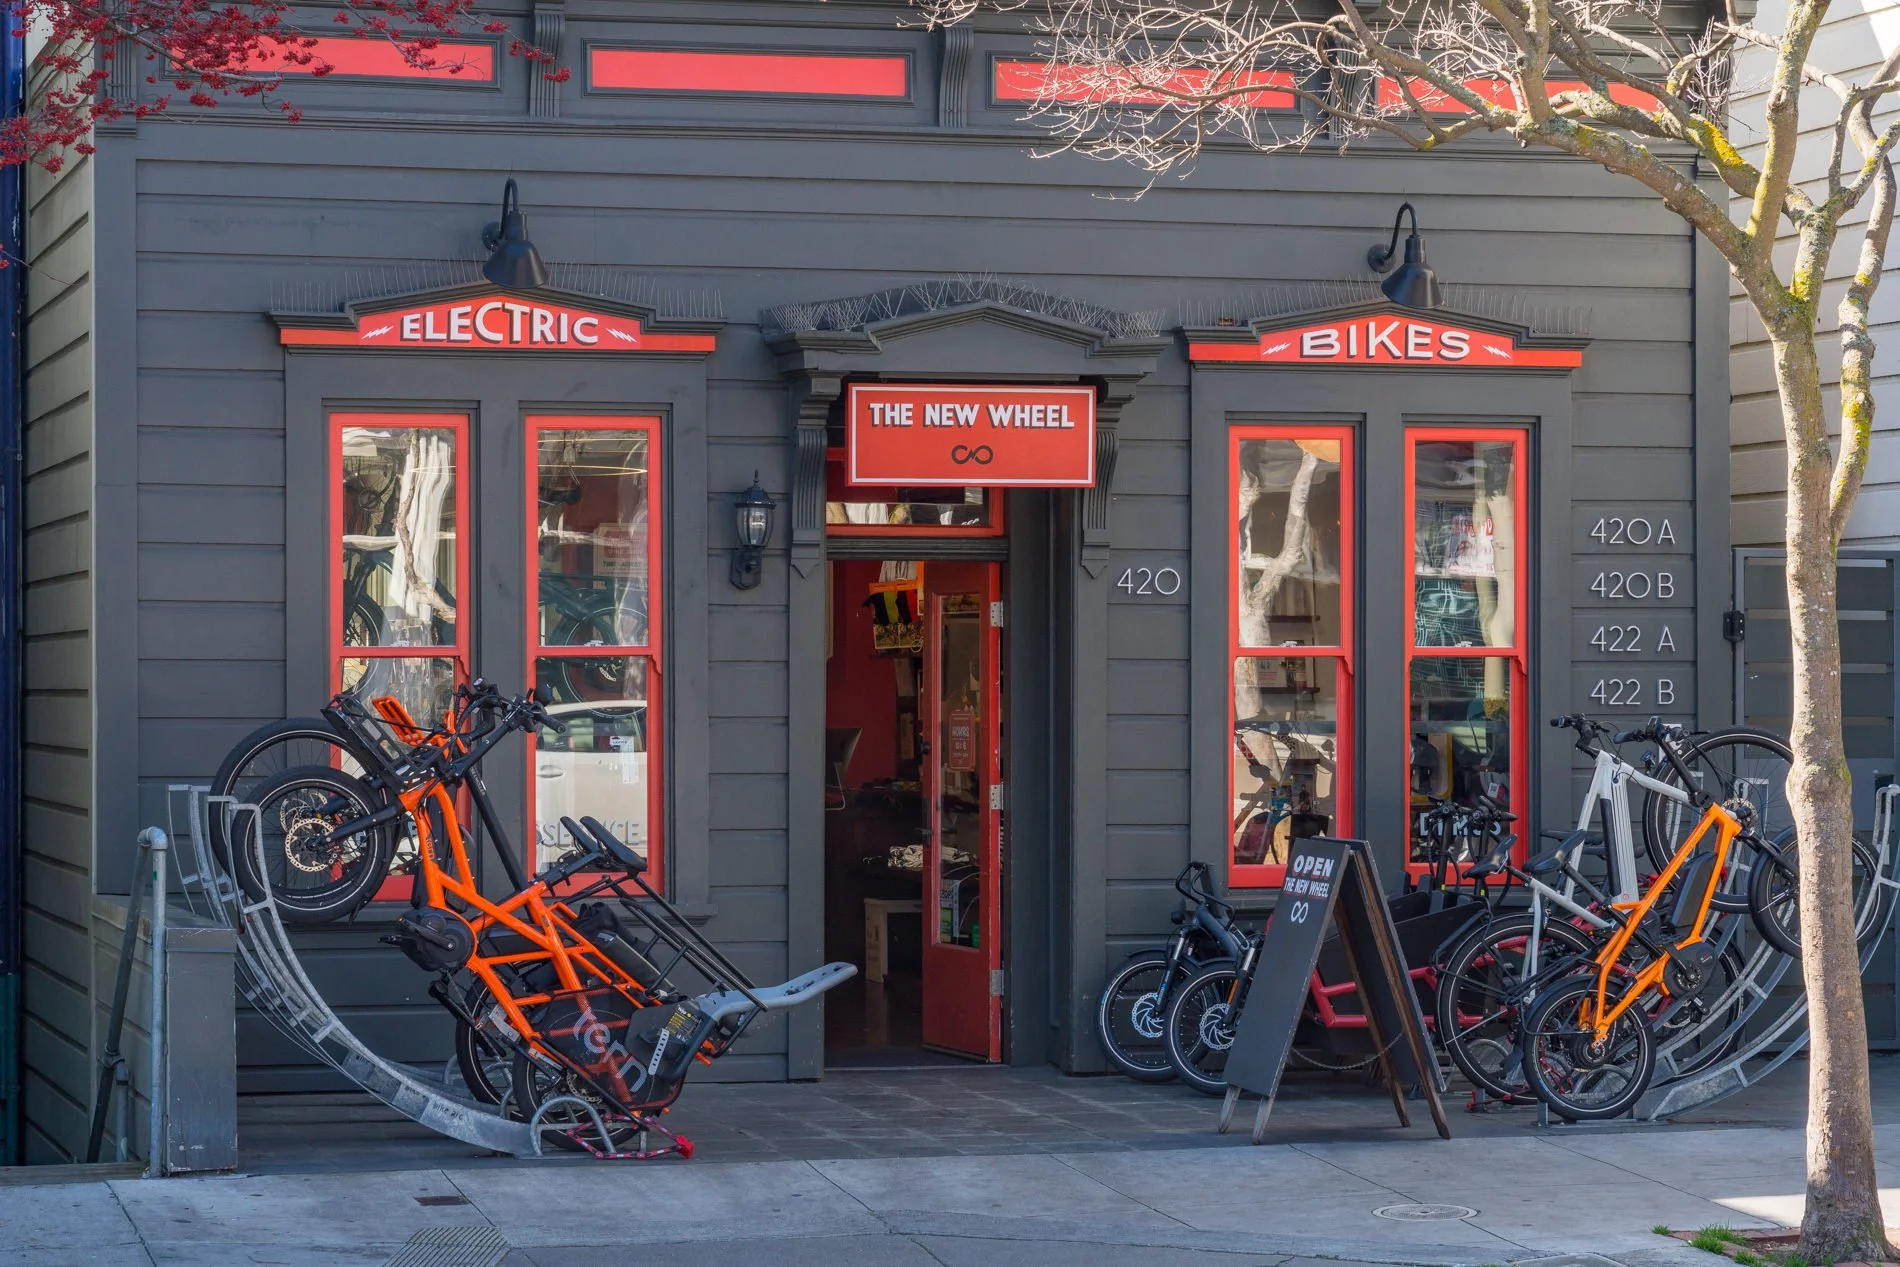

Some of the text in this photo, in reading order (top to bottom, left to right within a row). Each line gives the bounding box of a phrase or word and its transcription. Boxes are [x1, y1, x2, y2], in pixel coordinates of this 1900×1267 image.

[402, 302, 599, 344] ELECTRIC
[1301, 321, 1471, 359] BIKES
[869, 403, 1075, 428] THE NEW WHEEL
[1590, 518, 1652, 544] 420
[1117, 568, 1181, 595] 420
[1590, 571, 1651, 598] 420
[1590, 625, 1676, 652] 422 A
[1590, 678, 1675, 705] 422 B
[1292, 854, 1335, 878] OPEN
[1283, 877, 1330, 898] THE NEW WHEEL
